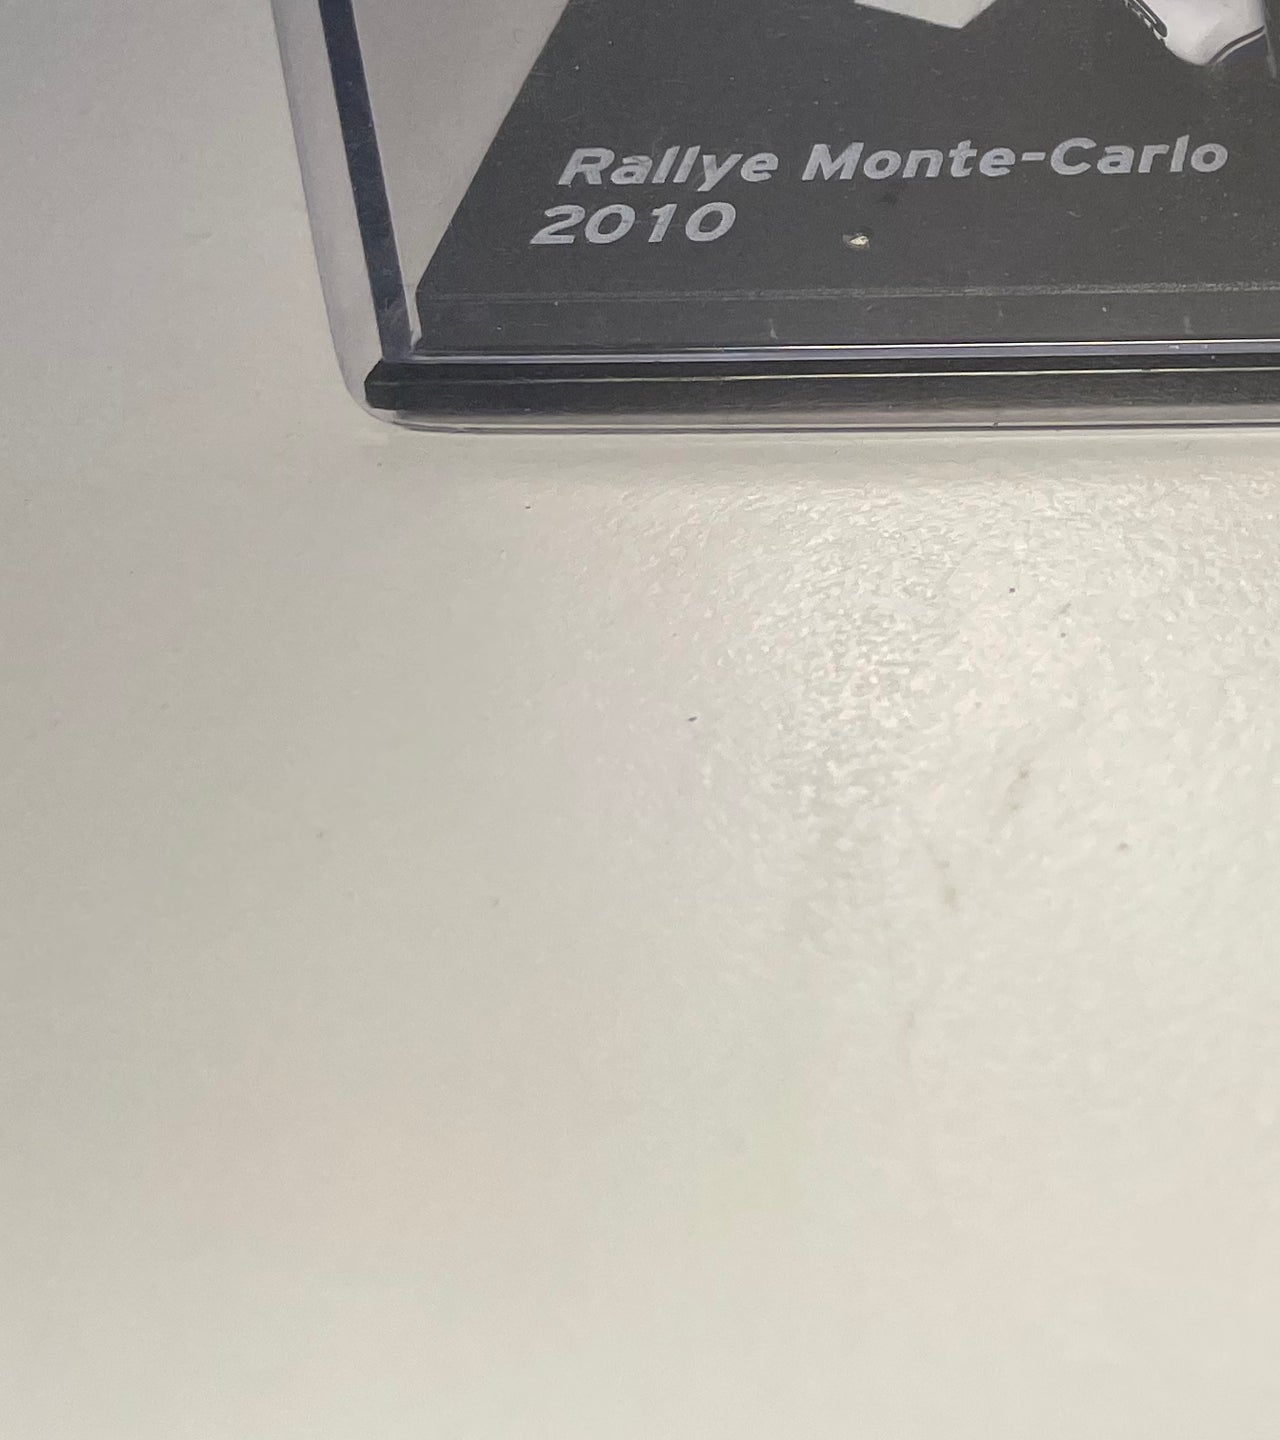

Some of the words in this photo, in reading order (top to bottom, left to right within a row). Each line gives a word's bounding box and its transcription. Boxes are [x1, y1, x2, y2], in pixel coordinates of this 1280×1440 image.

[557, 145, 779, 191] Rallye
[801, 135, 1229, 182] Monte-Carlo
[530, 202, 737, 245] 2010
